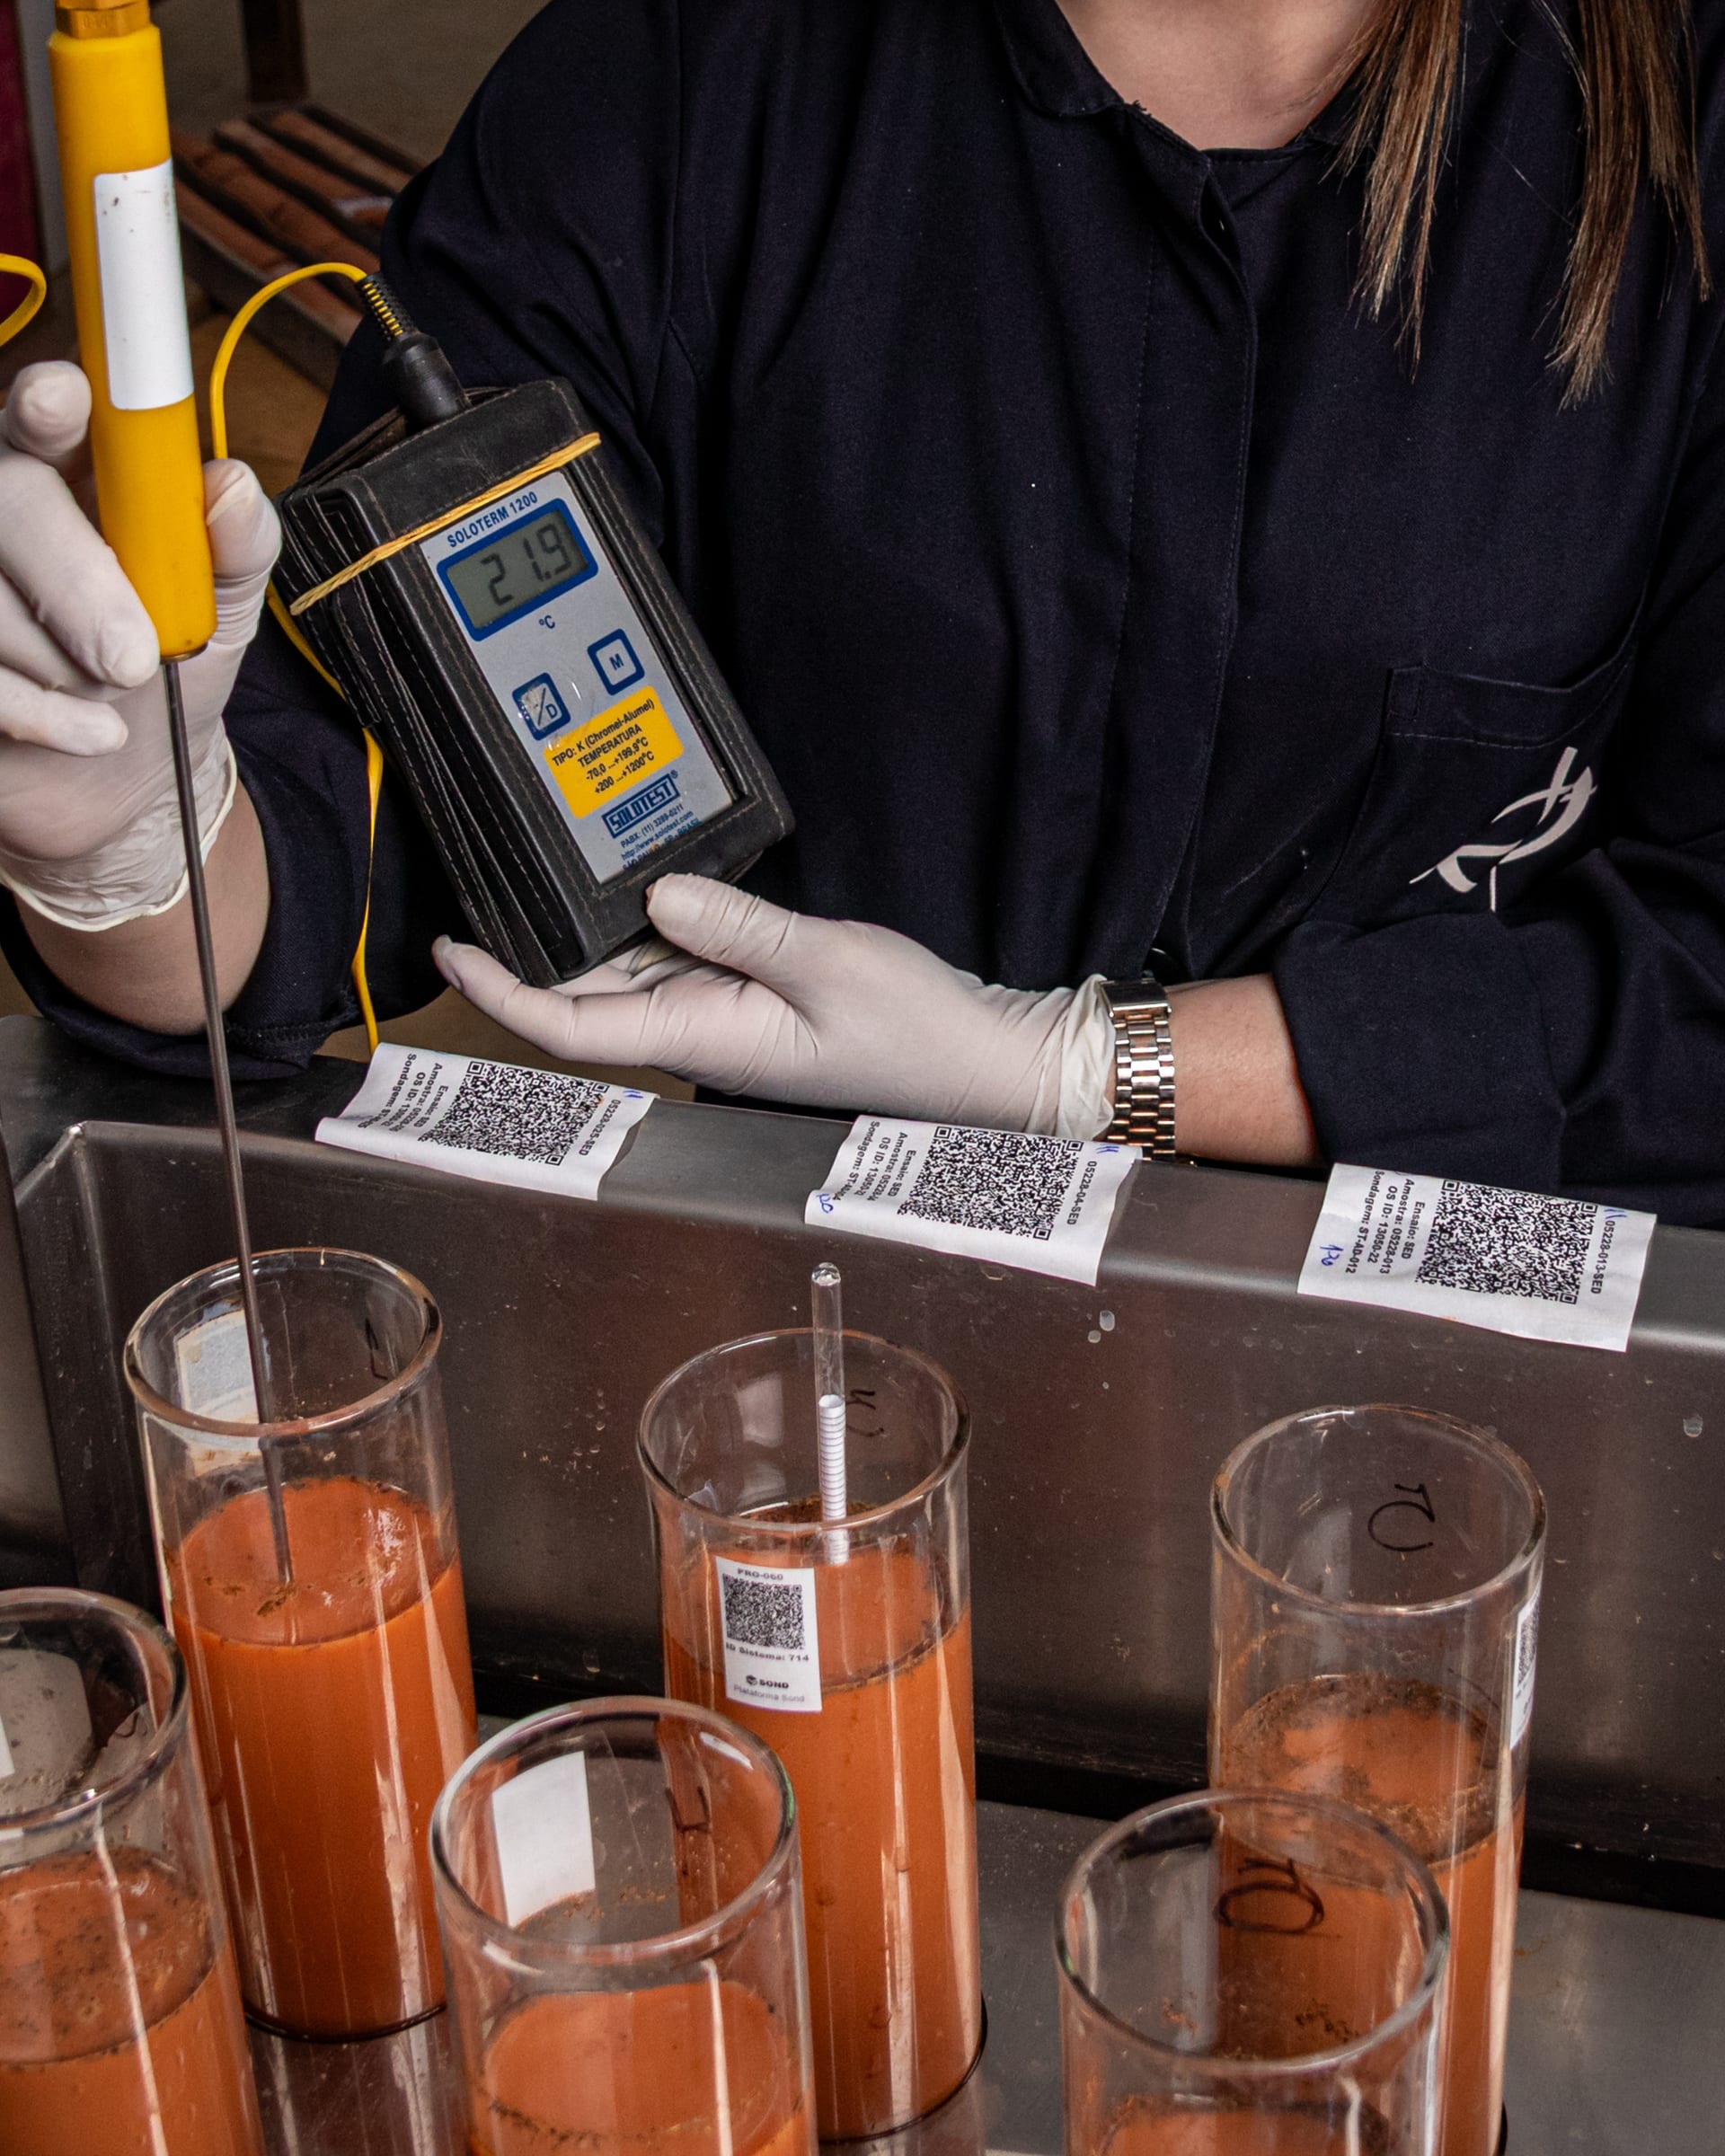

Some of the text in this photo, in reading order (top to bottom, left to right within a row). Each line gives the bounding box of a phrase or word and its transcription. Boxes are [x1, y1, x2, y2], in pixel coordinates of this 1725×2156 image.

[447, 491, 538, 548] SOLOTERM 1200
[480, 524, 571, 605] 21.9
[609, 653, 624, 670] M
[552, 699, 655, 766] TIPO: K (Chromel-Alumel)
[578, 724, 642, 767] TEMPERATURA
[586, 764, 606, 781] -70,0
[595, 776, 615, 794] +200
[608, 781, 672, 832] SOLOTEST
[641, 822, 655, 836] (11)
[385, 1053, 417, 1108] Sondagem:
[404, 1088, 420, 1101] ID:
[413, 1072, 427, 1086] OS
[416, 1063, 444, 1107] Amostra:
[425, 1085, 449, 1116] Ensaio:
[853, 1121, 880, 1170] Sondagem:
[872, 1151, 887, 1164] ID:
[879, 1137, 891, 1150] OS
[885, 1132, 908, 1172] Amostra:
[888, 1150, 916, 1197] Ensaio: SED
[1066, 1160, 1098, 1225] 05228-04-SED
[1345, 1171, 1385, 1274] Sondagem: ST-AD-012
[1367, 1186, 1398, 1264] OS ID: 13050-22
[1379, 1179, 1415, 1275] Amostra: 05228-013
[1401, 1201, 1426, 1259] Ensaio: SED
[1590, 1220, 1615, 1294] 05228-013-SED
[739, 1646, 786, 1662] Sistema:
[790, 1653, 809, 1662] 714
[733, 1684, 805, 1703] Plataforma Sond
[759, 1678, 789, 1689] SOND
